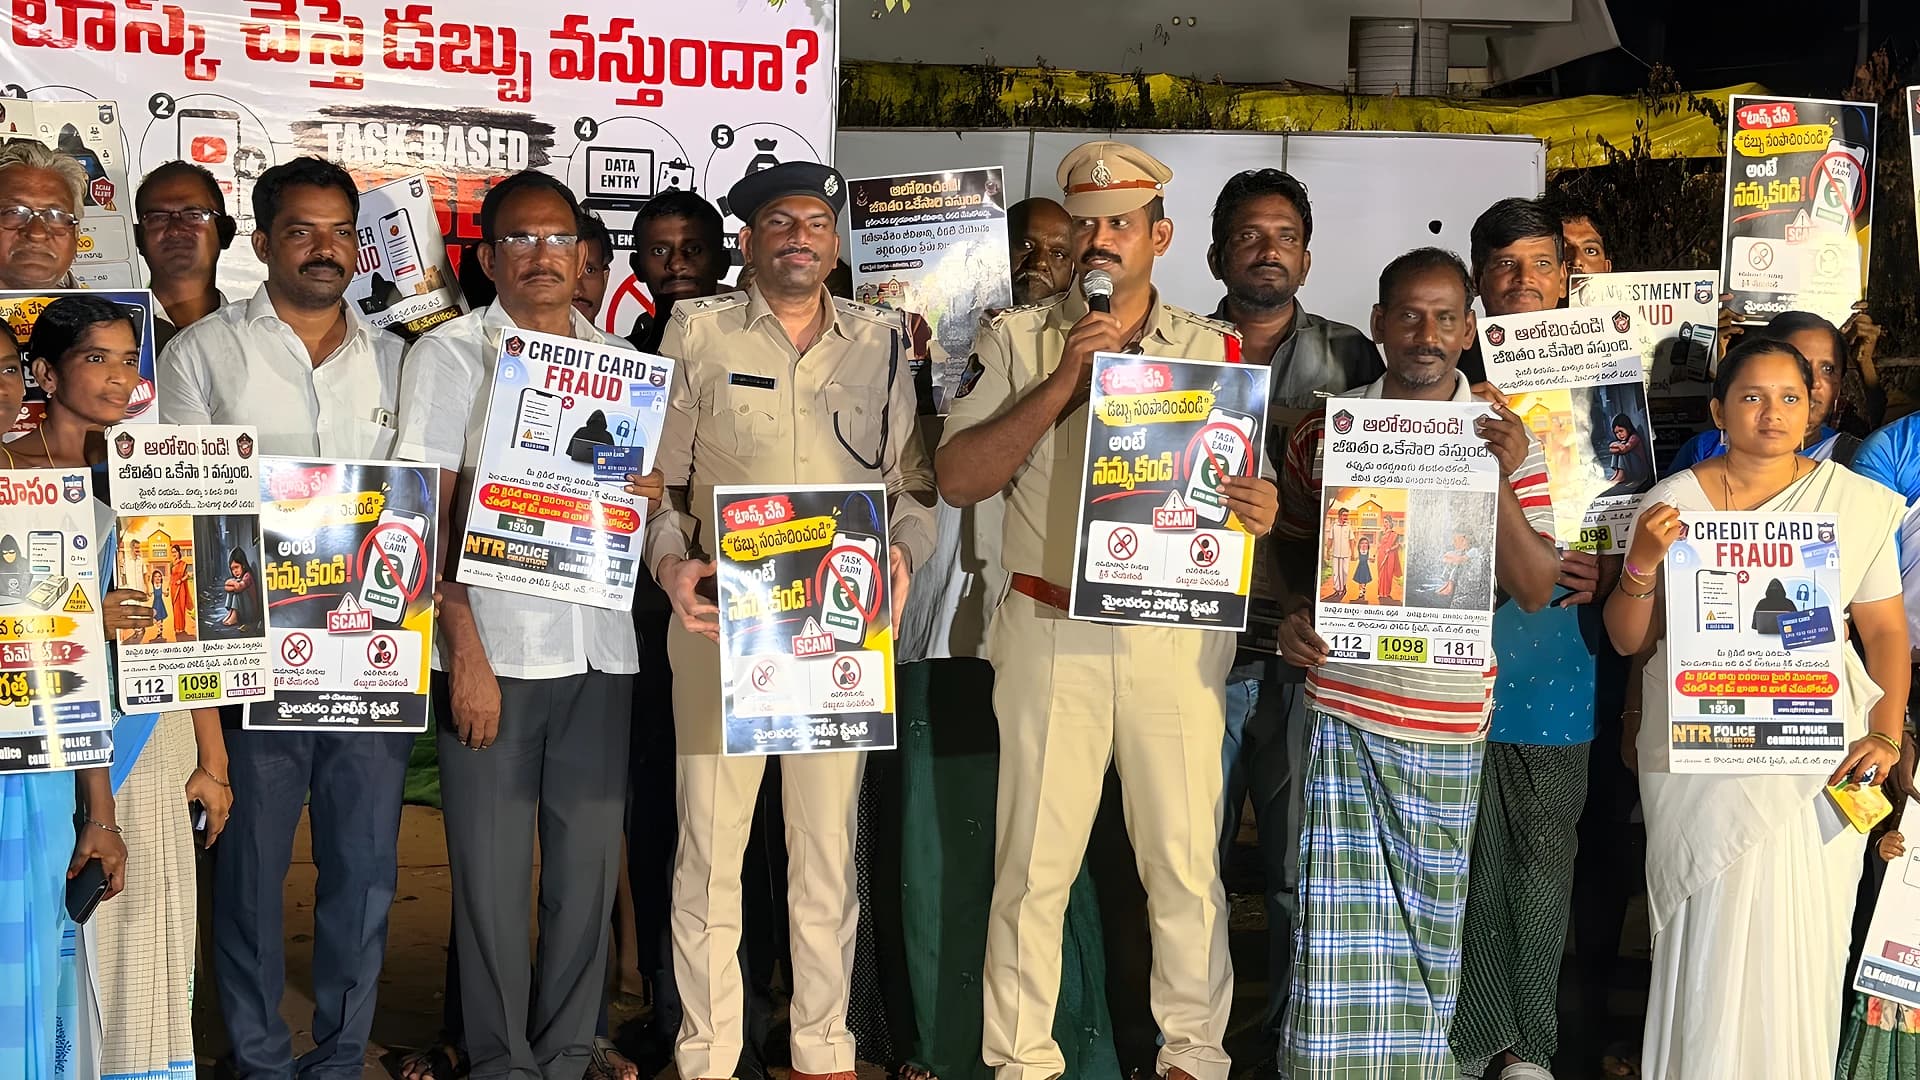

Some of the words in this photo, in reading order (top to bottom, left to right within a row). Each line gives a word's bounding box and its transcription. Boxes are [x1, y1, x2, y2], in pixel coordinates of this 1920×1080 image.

[383, 5, 532, 102] డబ్బు
[550, 14, 819, 107] వస్తుందా?
[155, 97, 169, 115] 2
[579, 120, 592, 138] 4
[716, 127, 729, 146] 5
[605, 157, 635, 173] DATA
[601, 174, 640, 190] ENTRY
[1515, 317, 1605, 341] ఆలోచించండి!
[528, 341, 595, 370] CREDIT
[599, 354, 647, 380] CARD
[1493, 347, 1535, 364] జీవితం
[1538, 342, 1583, 359] ఒకేసారి
[544, 365, 623, 402] FRAUD
[128, 383, 153, 404] AM
[1363, 414, 1464, 435] ఆలోచించండి!
[1108, 427, 1147, 451] అంటే
[1214, 431, 1236, 444] TASK
[1332, 440, 1379, 454] జీవితం
[1382, 440, 1435, 456] ఒకేసారి
[119, 463, 162, 479] జీవితం
[212, 464, 253, 484] వస్తుంది.
[1092, 450, 1181, 490] నమ్మకండి!
[764, 500, 786, 519] చేసి
[1156, 510, 1194, 527] SCAM
[507, 520, 534, 534] 1930
[1580, 528, 1608, 543] 098
[1694, 522, 1759, 541] CREDIT
[1765, 522, 1813, 541] CARD
[386, 531, 409, 544] TASK
[383, 541, 407, 554] EARN
[466, 534, 507, 559] NTR
[507, 542, 550, 560] POLICE
[1716, 542, 1793, 568] FRAUD
[841, 554, 862, 566] TASK
[265, 554, 353, 595] నమ్మకండి!
[331, 615, 369, 630] SCAM
[797, 636, 832, 654] SCAM
[1331, 634, 1362, 650] 112
[1381, 638, 1423, 654] 1098
[1444, 641, 1475, 656] 181
[1333, 650, 1358, 658] POLICE
[134, 678, 165, 694] 112
[181, 674, 218, 692] 1098
[233, 672, 257, 688] 181
[1709, 704, 1736, 714] 1930
[1672, 724, 1712, 743] NTR
[1713, 725, 1756, 737] POLICE
[1800, 725, 1828, 735] POLICE
[1898, 951, 1920, 968] 193
